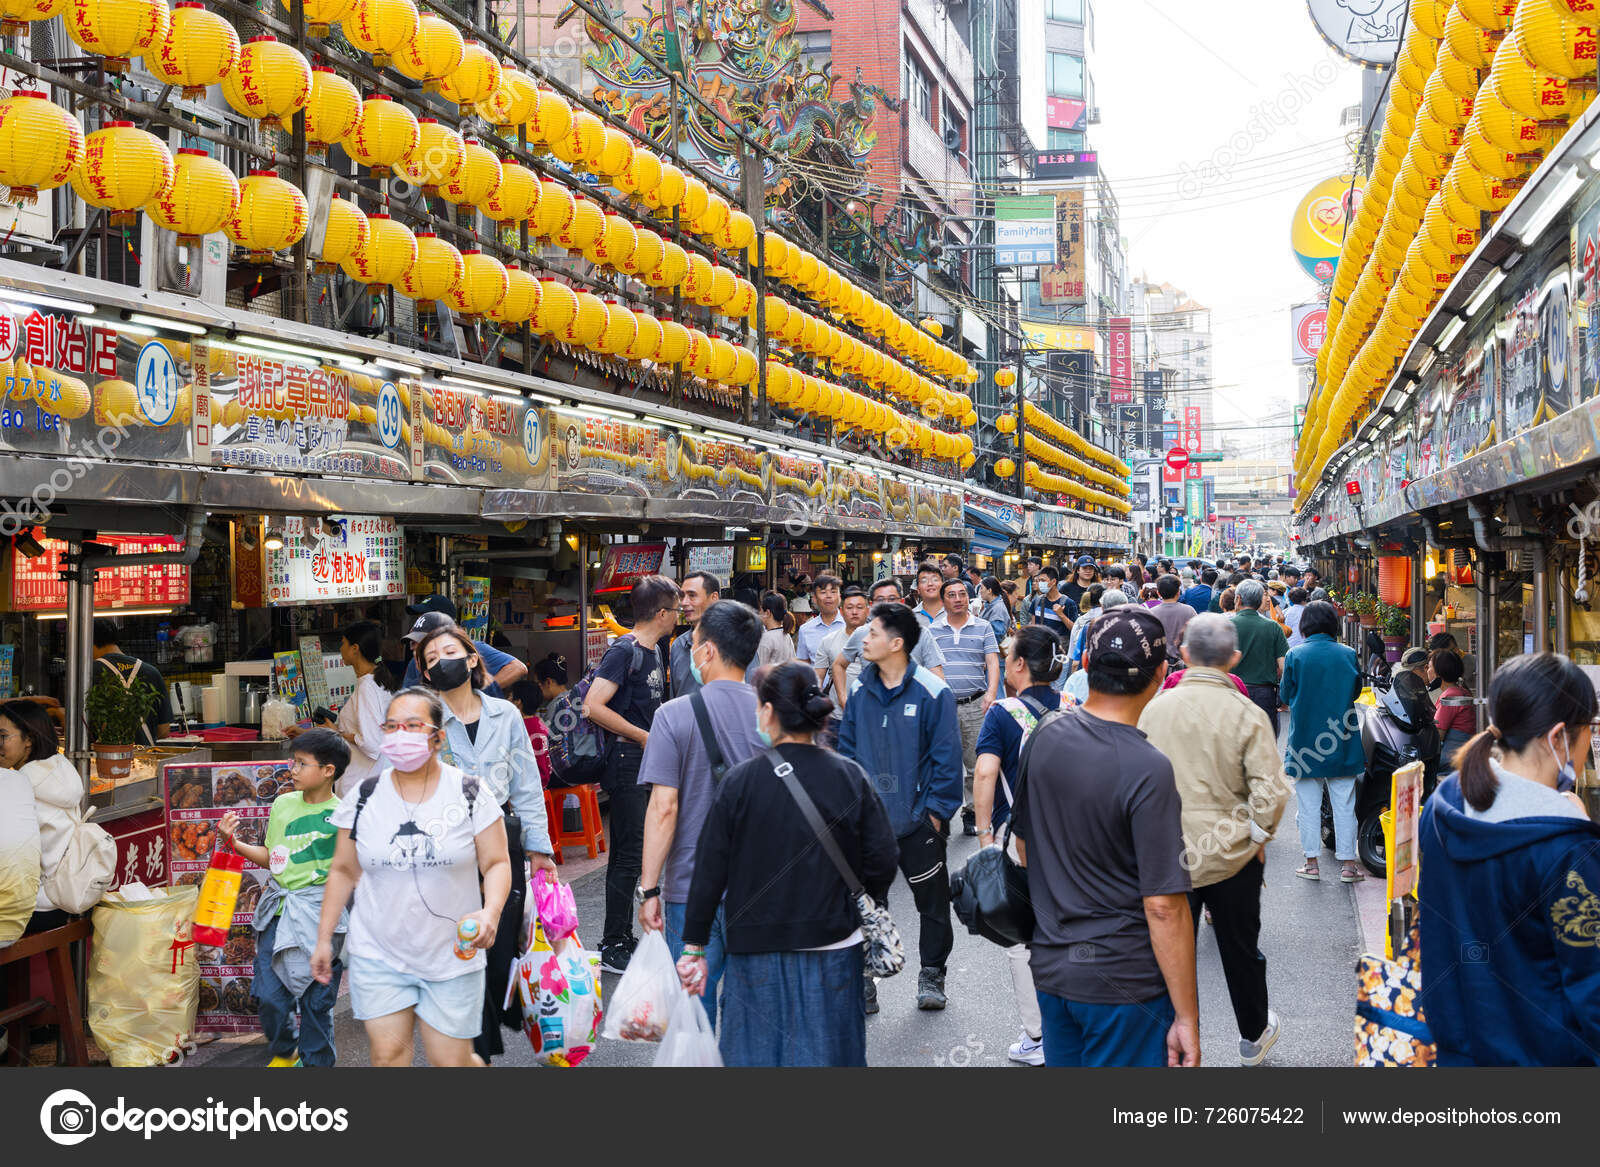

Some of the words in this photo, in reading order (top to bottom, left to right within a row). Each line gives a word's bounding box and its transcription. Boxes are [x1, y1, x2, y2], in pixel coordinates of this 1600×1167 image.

[998, 226, 1054, 238] FamilyMart
[24, 310, 119, 377] 創始店
[1115, 332, 1126, 386] SHISEIDO
[144, 357, 170, 411] 41
[236, 354, 351, 420] 謝記章魚腳
[36, 406, 61, 431] Ice
[382, 393, 400, 437] 39
[526, 419, 539, 456] 37
[452, 453, 487, 472] Pao-Pao
[999, 508, 1012, 521] 25
[330, 550, 367, 584] 泡泡冰
[1128, 618, 1145, 636] NEW
[1139, 635, 1153, 660] YORK
